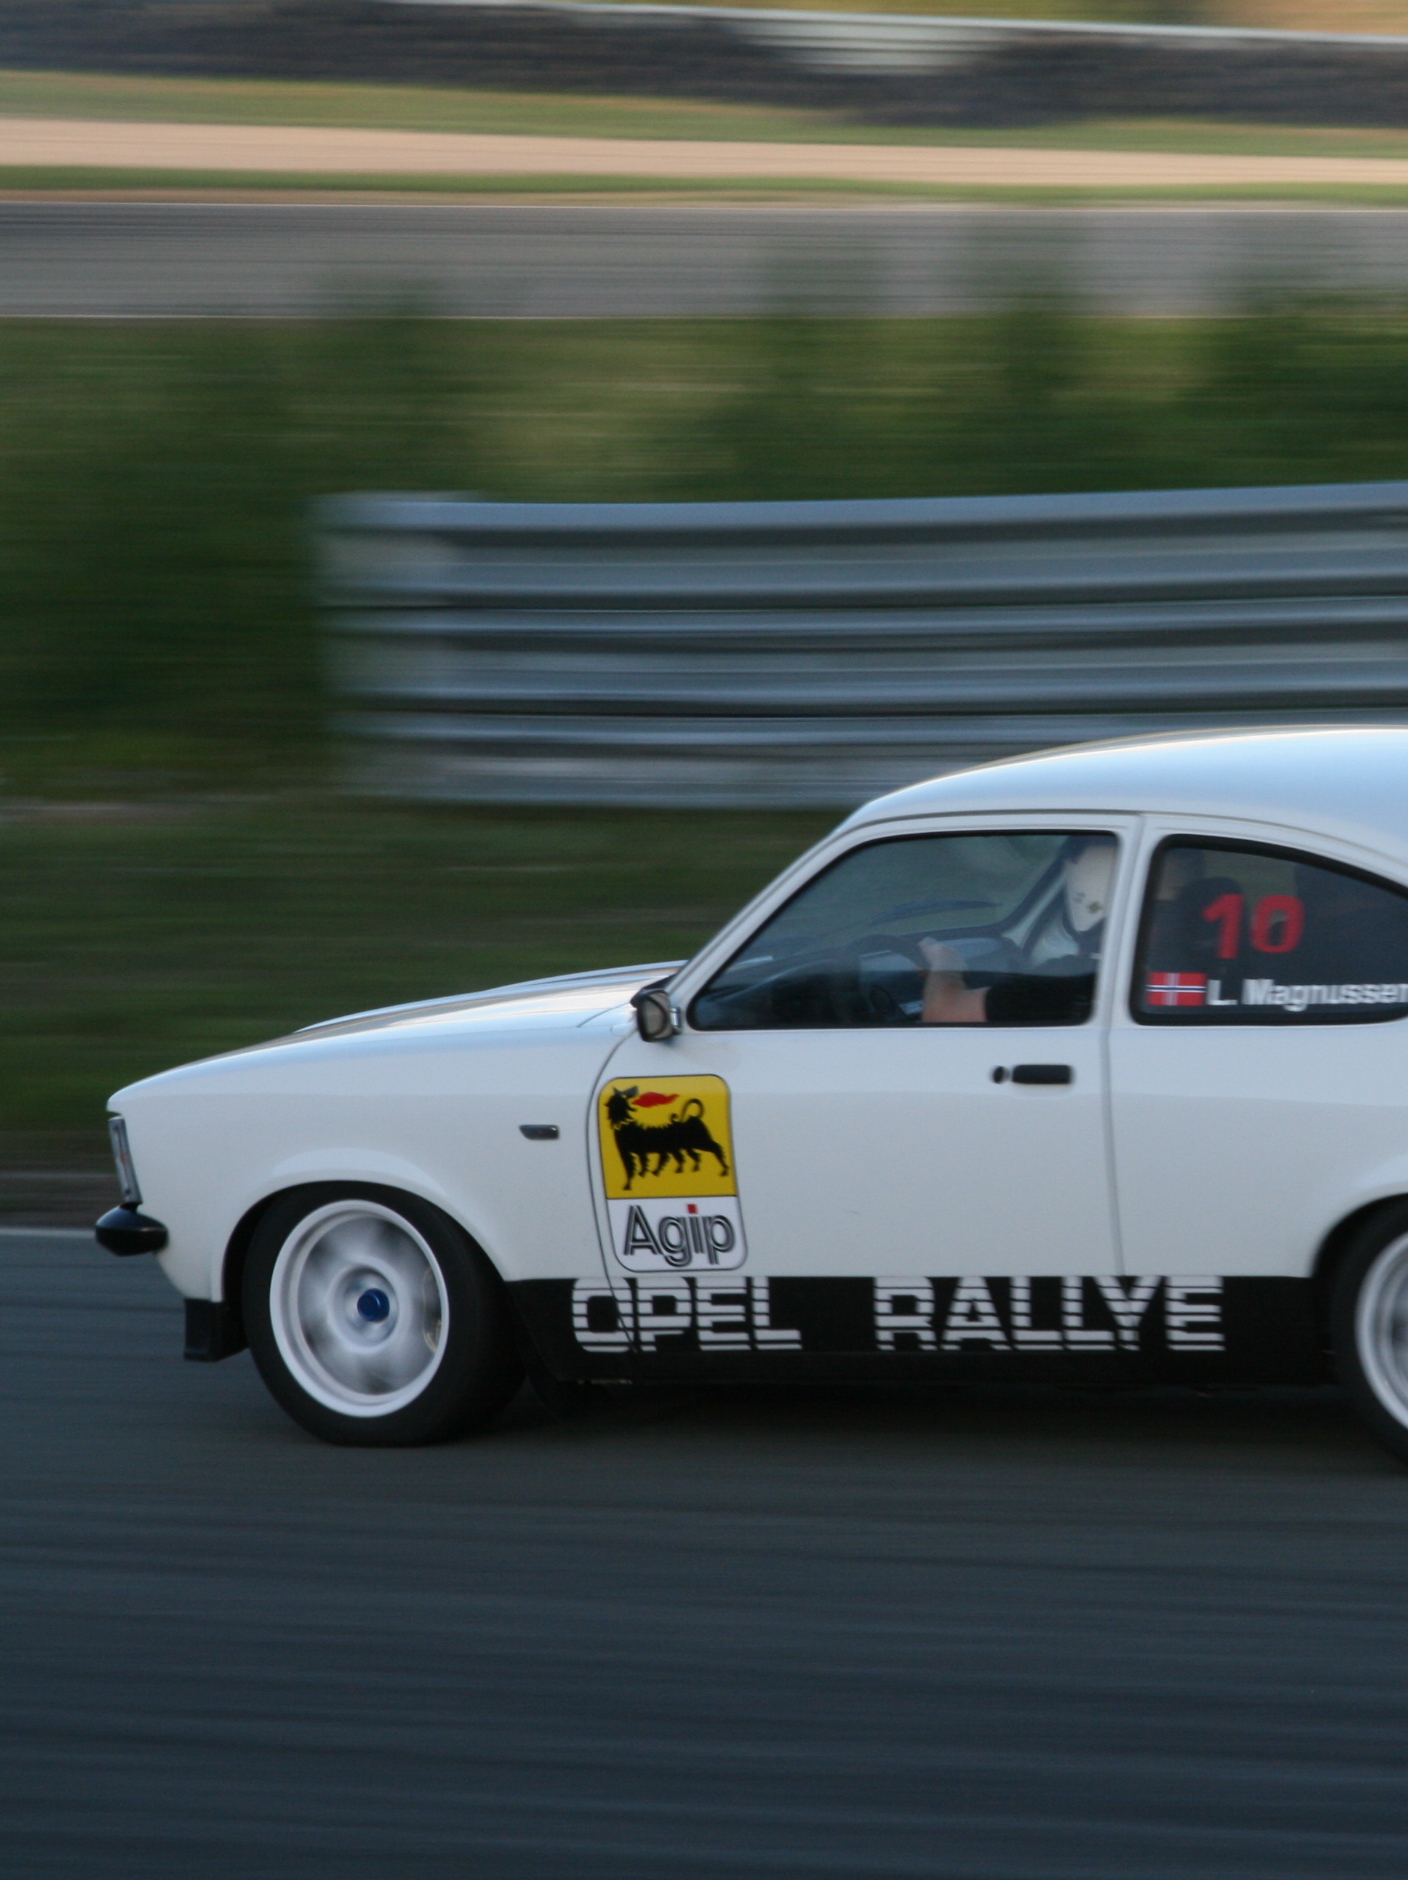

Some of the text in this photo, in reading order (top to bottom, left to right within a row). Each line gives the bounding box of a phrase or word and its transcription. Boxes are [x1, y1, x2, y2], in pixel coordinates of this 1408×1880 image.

[1202, 893, 1306, 960] 10
[623, 1203, 735, 1267] Agip
[572, 1276, 1225, 1353] OPEL RALLYE
